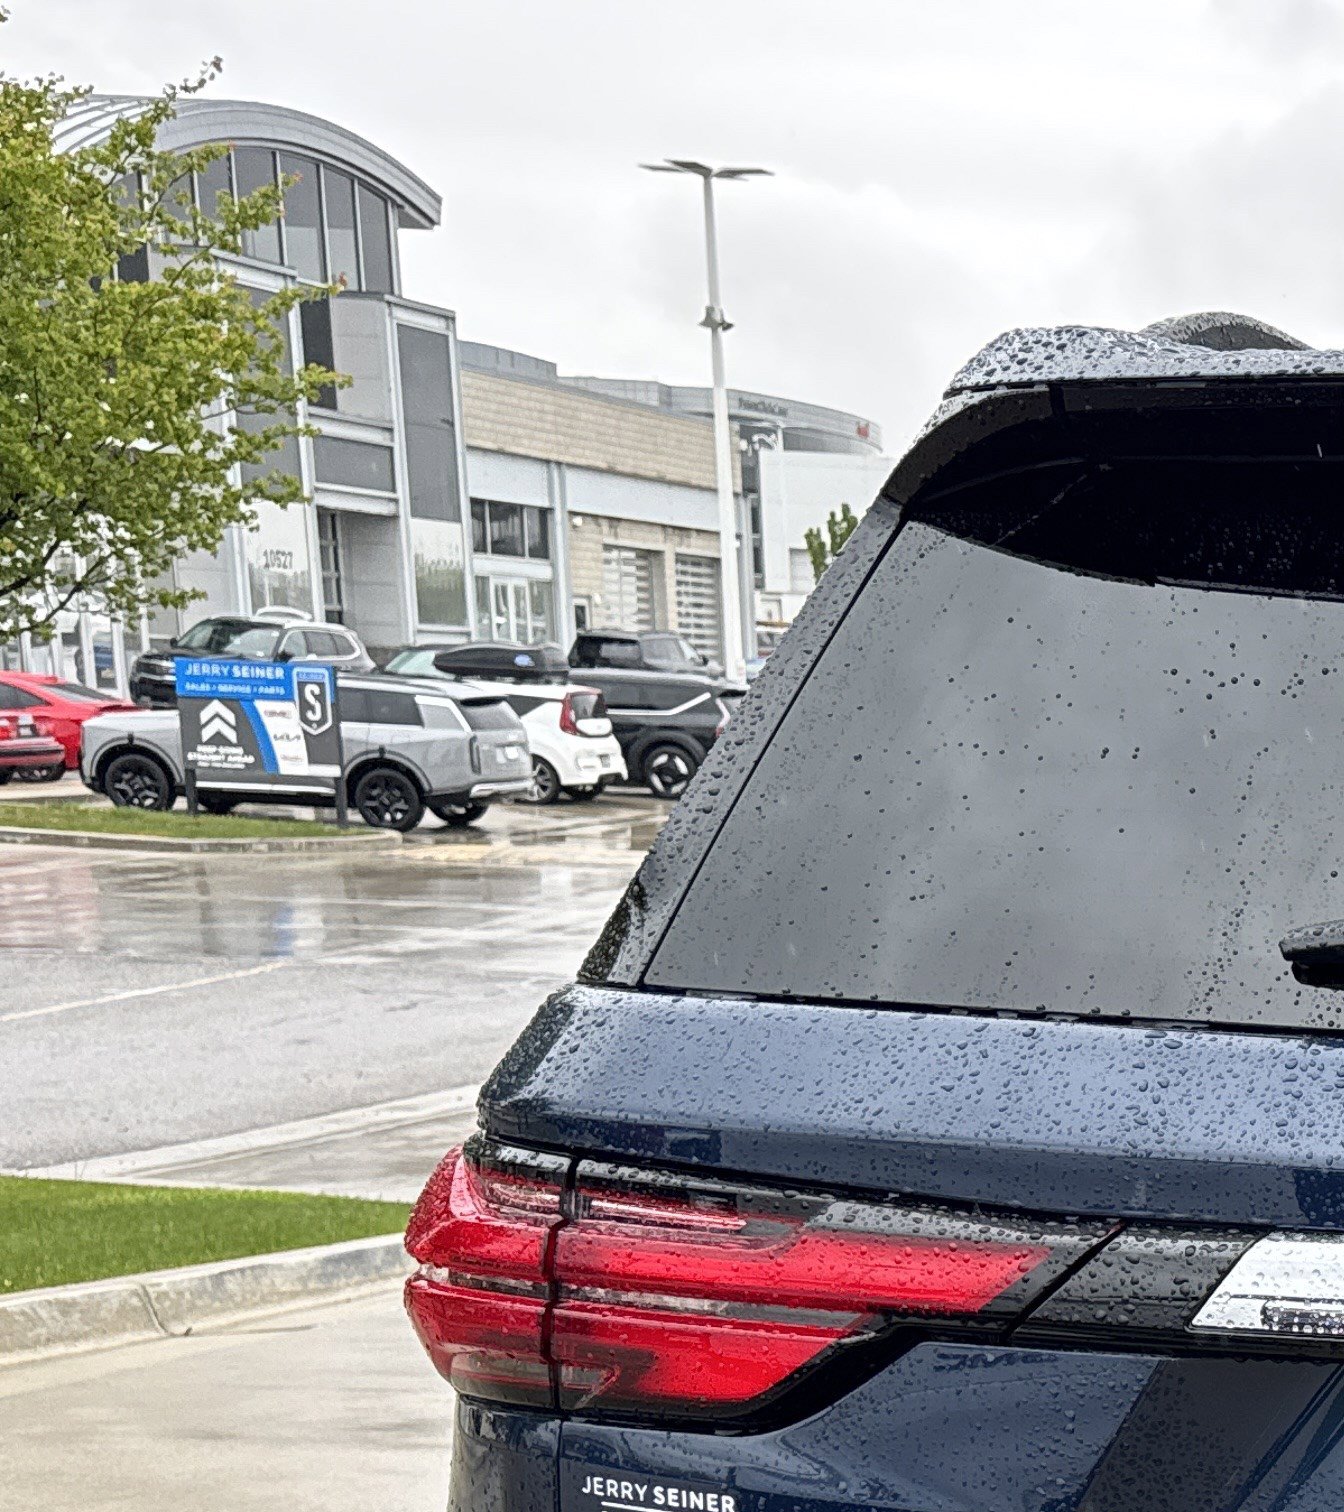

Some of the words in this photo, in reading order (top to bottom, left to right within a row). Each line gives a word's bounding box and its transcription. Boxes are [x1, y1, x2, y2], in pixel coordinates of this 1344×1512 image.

[184, 663, 229, 677] JERRY
[231, 665, 285, 680] SEINER
[581, 1475, 648, 1502] JERRY
